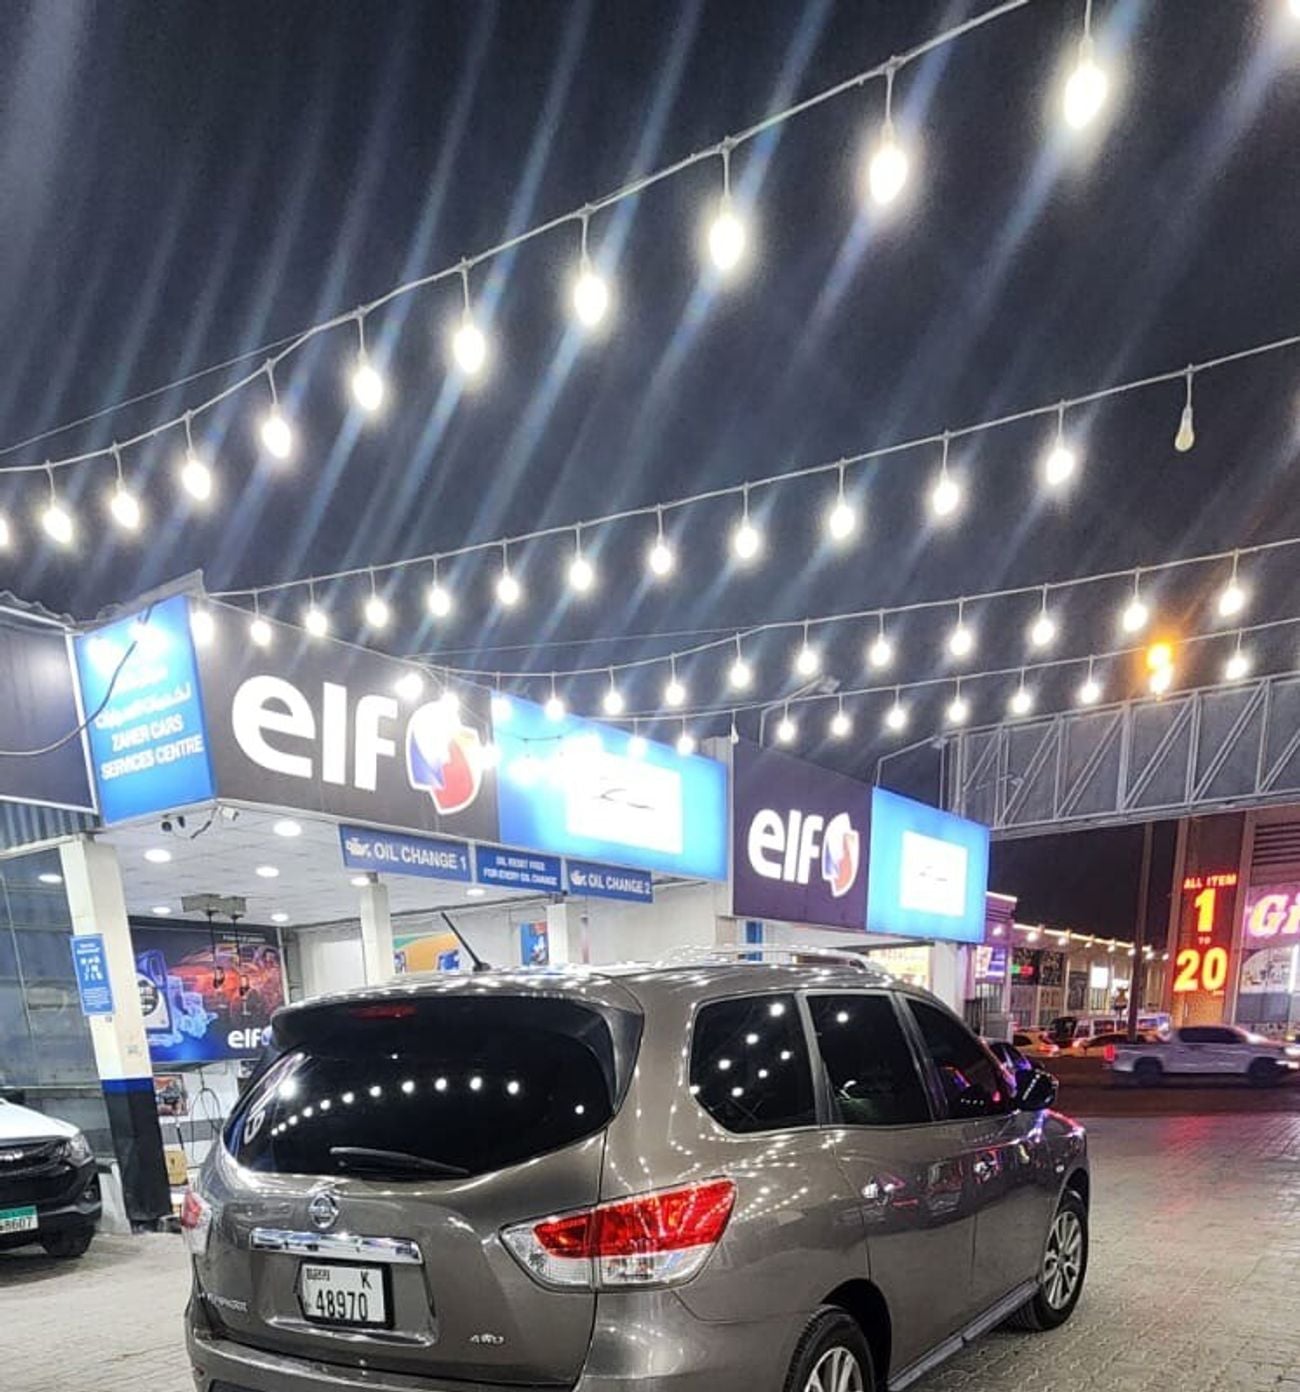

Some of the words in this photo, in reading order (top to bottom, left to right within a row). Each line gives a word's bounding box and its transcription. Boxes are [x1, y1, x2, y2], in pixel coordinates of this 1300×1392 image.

[150, 712, 184, 740] CARS
[232, 675, 399, 792] elf
[100, 748, 155, 781] SERVICES
[155, 733, 205, 765] CENTRE
[373, 842, 400, 863] OIL
[401, 845, 458, 870] CHANGE
[459, 855, 467, 872] 1
[747, 808, 824, 885] elf
[588, 872, 606, 890] OIL
[606, 875, 644, 894] CHANGE
[644, 882, 652, 895] 2
[1183, 877, 1203, 889] ALL
[1206, 873, 1237, 887] ITEM
[1194, 887, 1216, 932] 1
[1173, 946, 1228, 992] 20
[227, 1029, 262, 1049] elf
[360, 1270, 373, 1290] K
[316, 1289, 369, 1321] 48970
